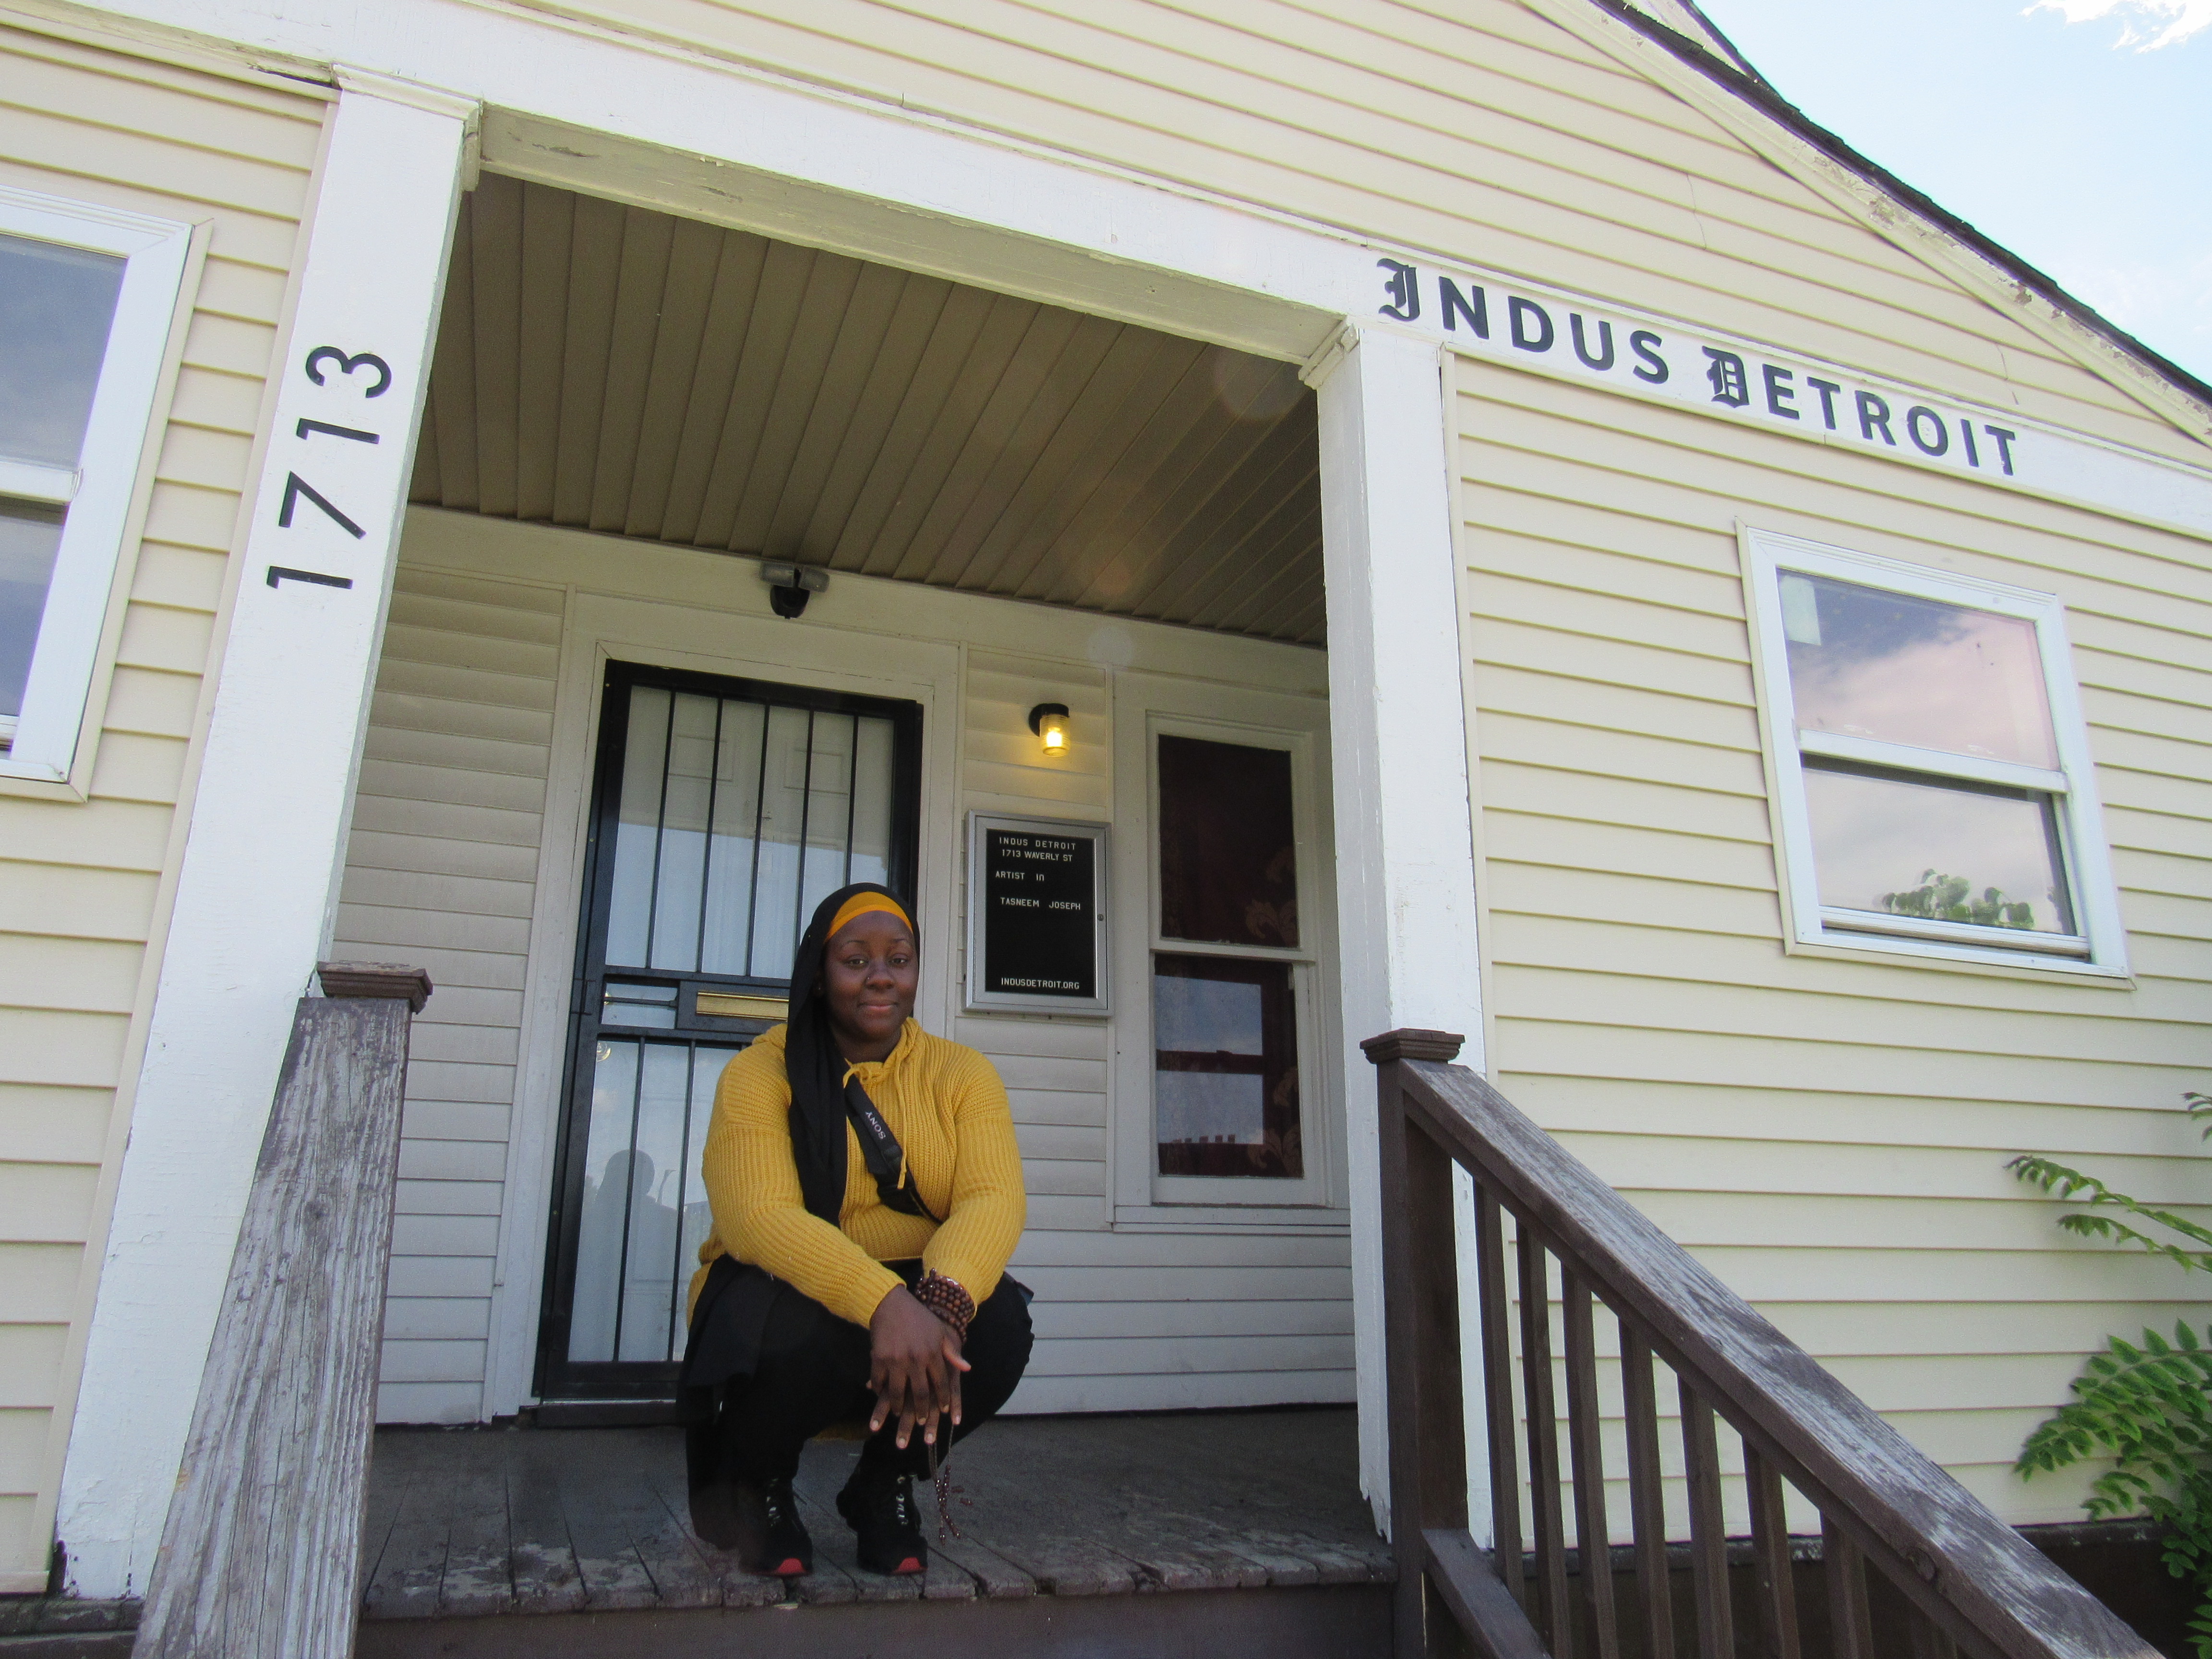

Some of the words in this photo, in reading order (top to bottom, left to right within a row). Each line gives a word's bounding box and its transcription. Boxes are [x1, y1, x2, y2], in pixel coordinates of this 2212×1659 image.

[1377, 257, 1670, 385] INDUS
[1702, 345, 2016, 476] DETROIT
[266, 346, 392, 589] 1713
[999, 837, 1028, 847] INDUS
[1035, 840, 1076, 850] DETROIT
[1002, 849, 1021, 858] 1713
[1024, 851, 1059, 861] WAVERLY
[1062, 854, 1073, 862] ST
[995, 870, 1025, 880] ARTIST
[1000, 897, 1040, 908] TASNEEM
[1048, 901, 1081, 911] JOSEPH
[1001, 977, 1080, 990] INDUSDETROIT.ORG
[865, 1111, 886, 1140] SONY
